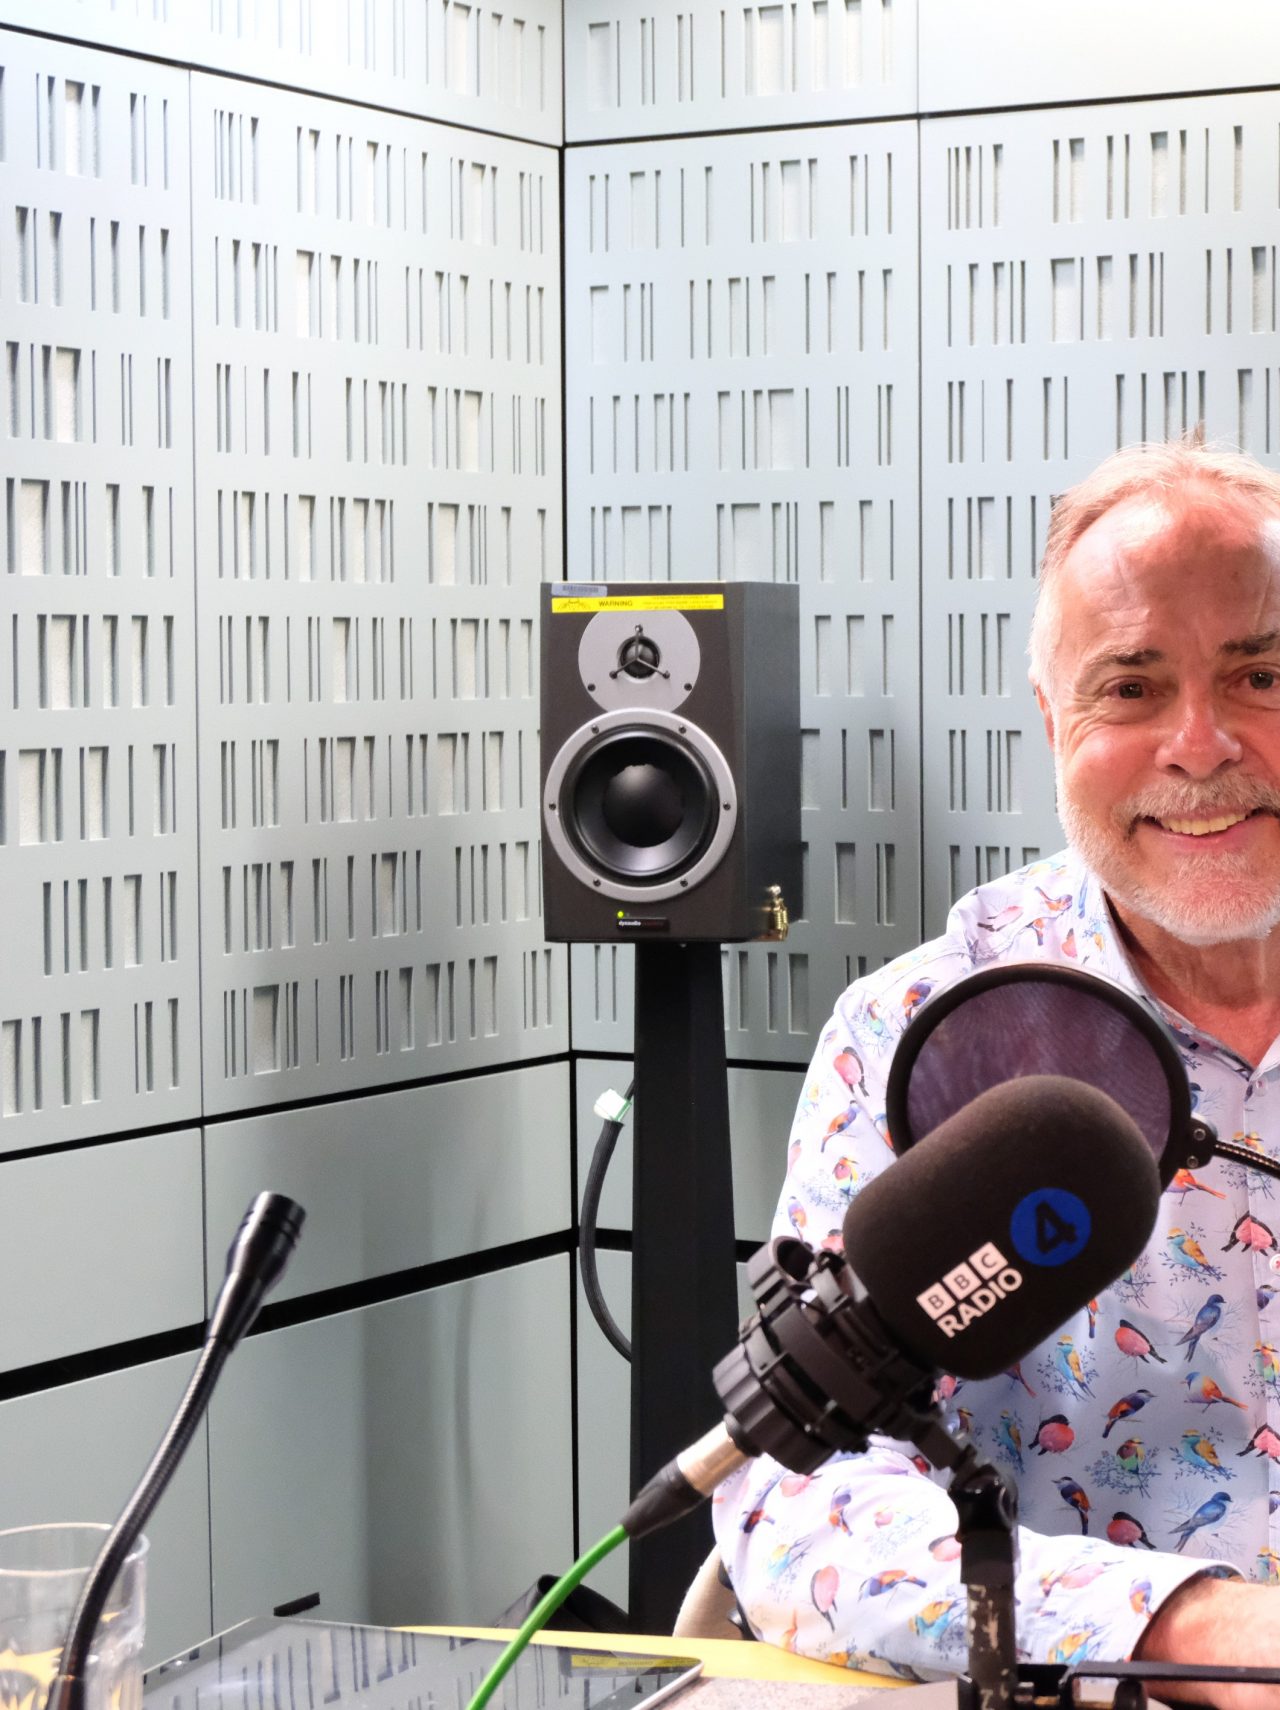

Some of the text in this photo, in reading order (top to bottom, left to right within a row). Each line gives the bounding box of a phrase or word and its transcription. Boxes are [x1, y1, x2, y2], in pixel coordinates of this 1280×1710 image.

[1036, 1202, 1077, 1254] 4
[921, 1246, 1003, 1316] BBC
[937, 1268, 1023, 1338] RADIO
